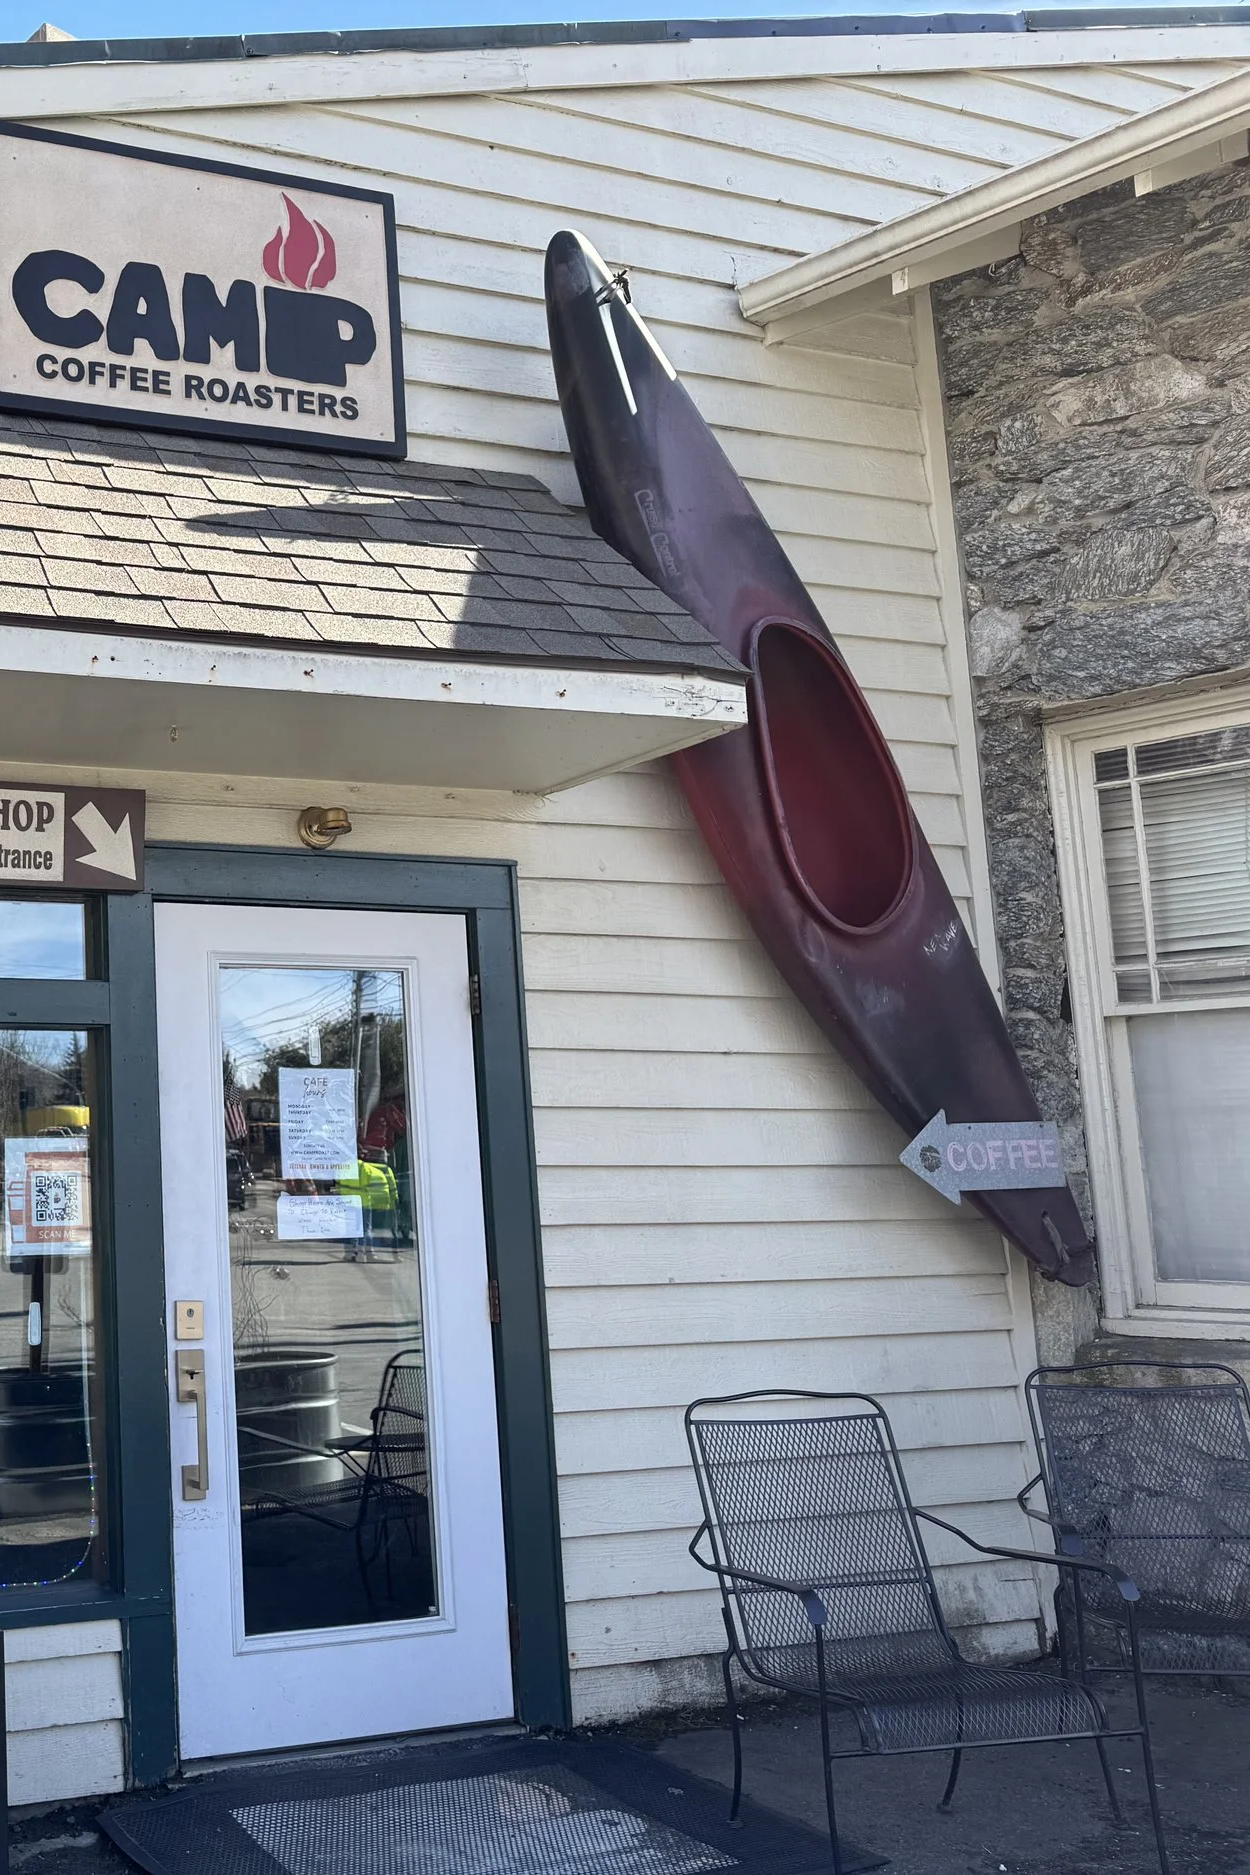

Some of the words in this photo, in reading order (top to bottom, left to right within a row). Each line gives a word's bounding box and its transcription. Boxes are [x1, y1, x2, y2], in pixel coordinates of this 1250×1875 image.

[11, 249, 377, 387] CAMP
[36, 353, 172, 396] COFFEE
[184, 374, 359, 420] ROASTERS
[303, 1077, 328, 1087] CAFE
[946, 1139, 1059, 1171] COFFEE
[39, 1231, 62, 1239] SCAN
[64, 1230, 78, 1239] ME
